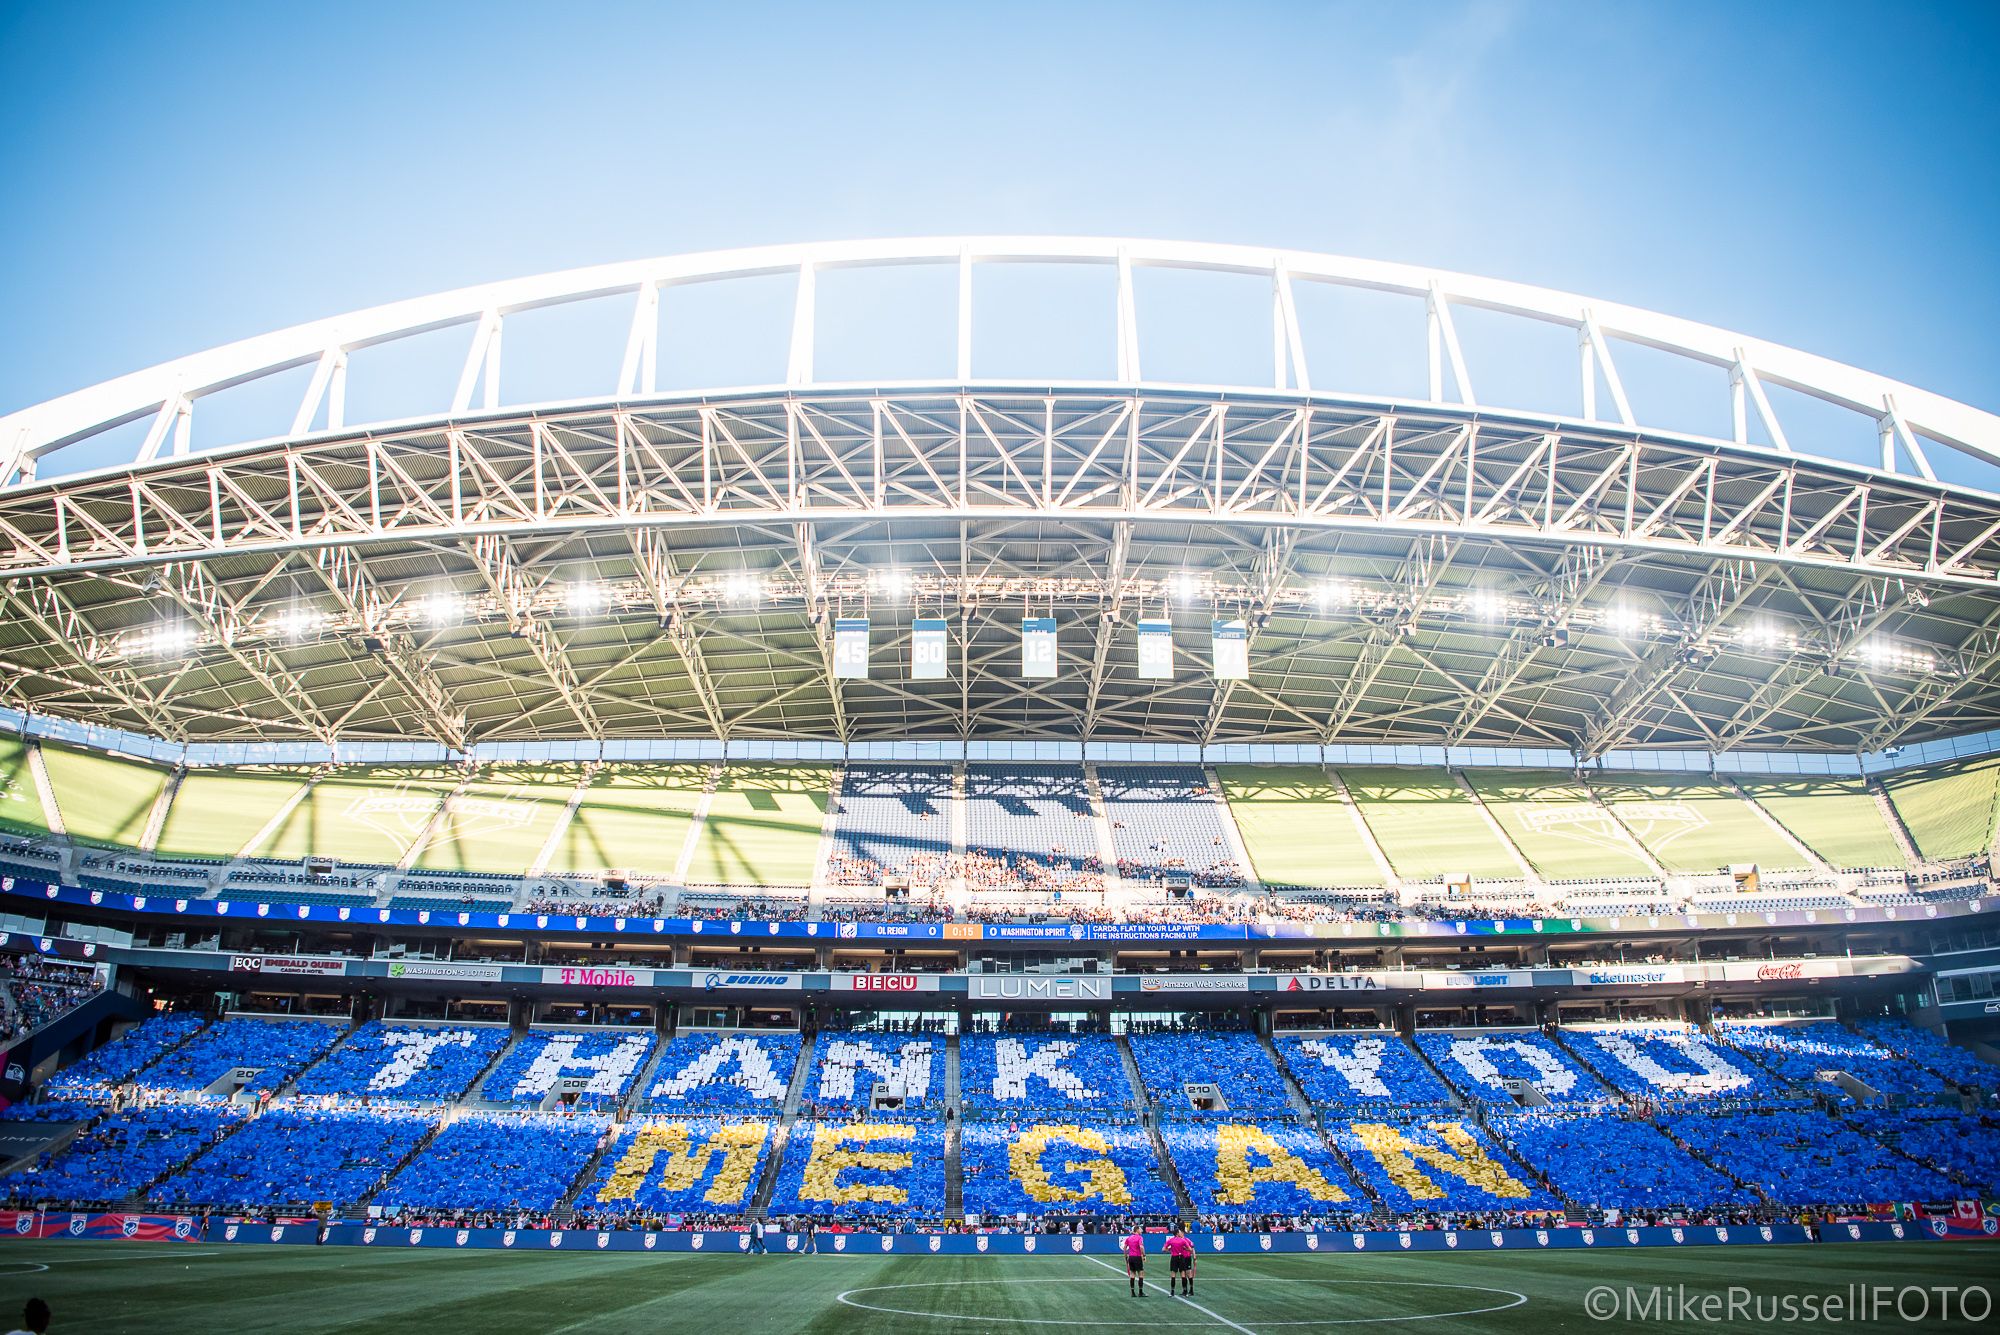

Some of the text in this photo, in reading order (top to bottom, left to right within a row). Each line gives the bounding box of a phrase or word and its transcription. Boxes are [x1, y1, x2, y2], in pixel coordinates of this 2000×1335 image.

[836, 641, 866, 663] 45
[915, 641, 944, 664] 80
[1027, 640, 1052, 662] 12
[1141, 641, 1169, 664] 96
[1216, 642, 1243, 664] 71
[877, 926, 908, 935] OL REIGN
[928, 926, 937, 936] 0
[952, 927, 974, 937] 0:15
[989, 927, 998, 936] 0
[1000, 927, 1066, 937] WASHINGTON SPIRIT
[234, 957, 261, 970] EQC
[264, 958, 343, 970] EMERALD QUEEN
[405, 967, 500, 978] WASHINGTON'S LOTTERY
[579, 968, 635, 986] Mobile
[1590, 971, 1665, 984] ticketmaster
[725, 975, 788, 985] BOEING
[855, 976, 916, 990] BECU
[1143, 978, 1160, 986] aws
[1163, 980, 1247, 988] Amazon Web Services
[1310, 976, 1377, 990] DELTA
[1473, 975, 1508, 986] LIGHT
[980, 978, 1101, 998] LUMEN
[367, 1031, 1754, 1100] THANK YOU
[236, 1070, 262, 1078] 20
[596, 1121, 1531, 1204] MEGAN
